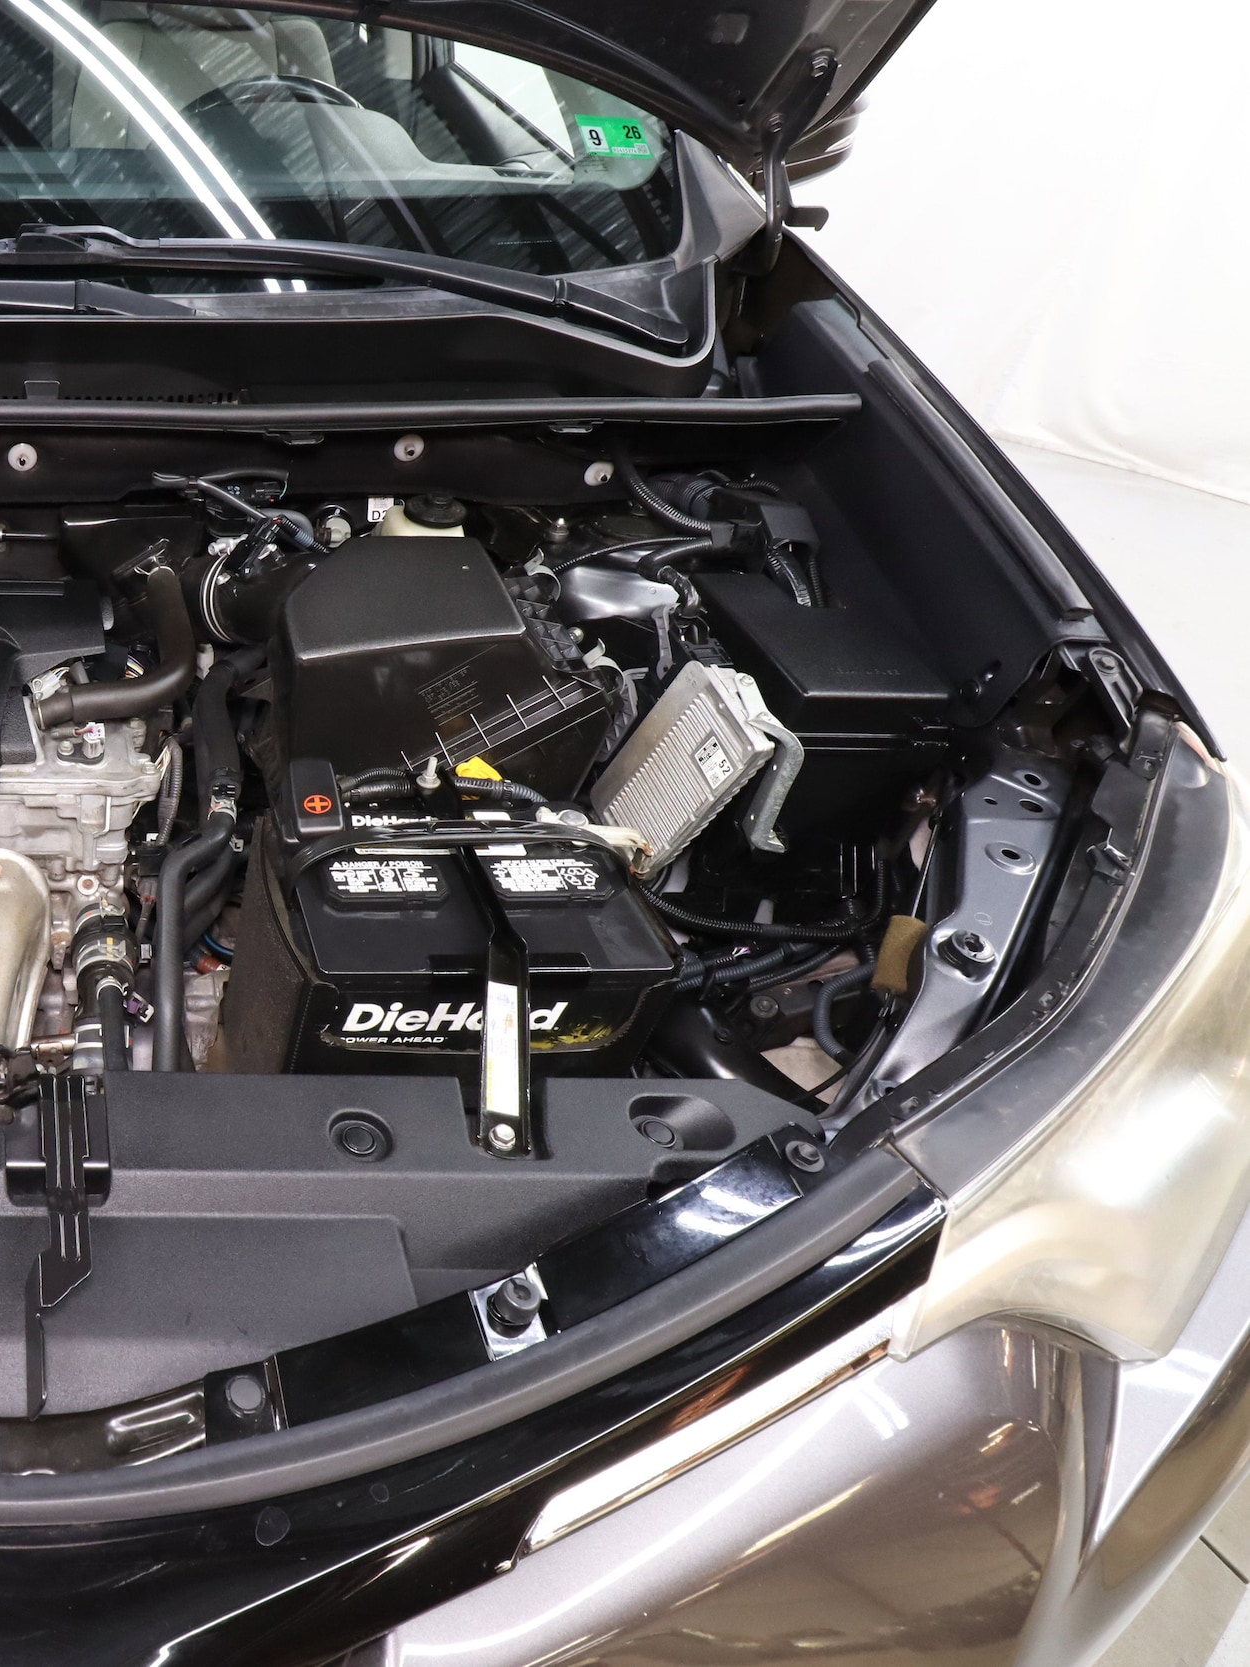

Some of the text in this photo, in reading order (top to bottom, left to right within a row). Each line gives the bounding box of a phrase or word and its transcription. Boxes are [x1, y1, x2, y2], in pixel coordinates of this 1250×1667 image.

[588, 129, 602, 146] 9
[622, 125, 642, 140] 26
[341, 860, 381, 868] DANGER
[389, 860, 425, 868] POISON
[342, 1001, 569, 1032] DieHd
[339, 1036, 445, 1044] OWER AHEAD
